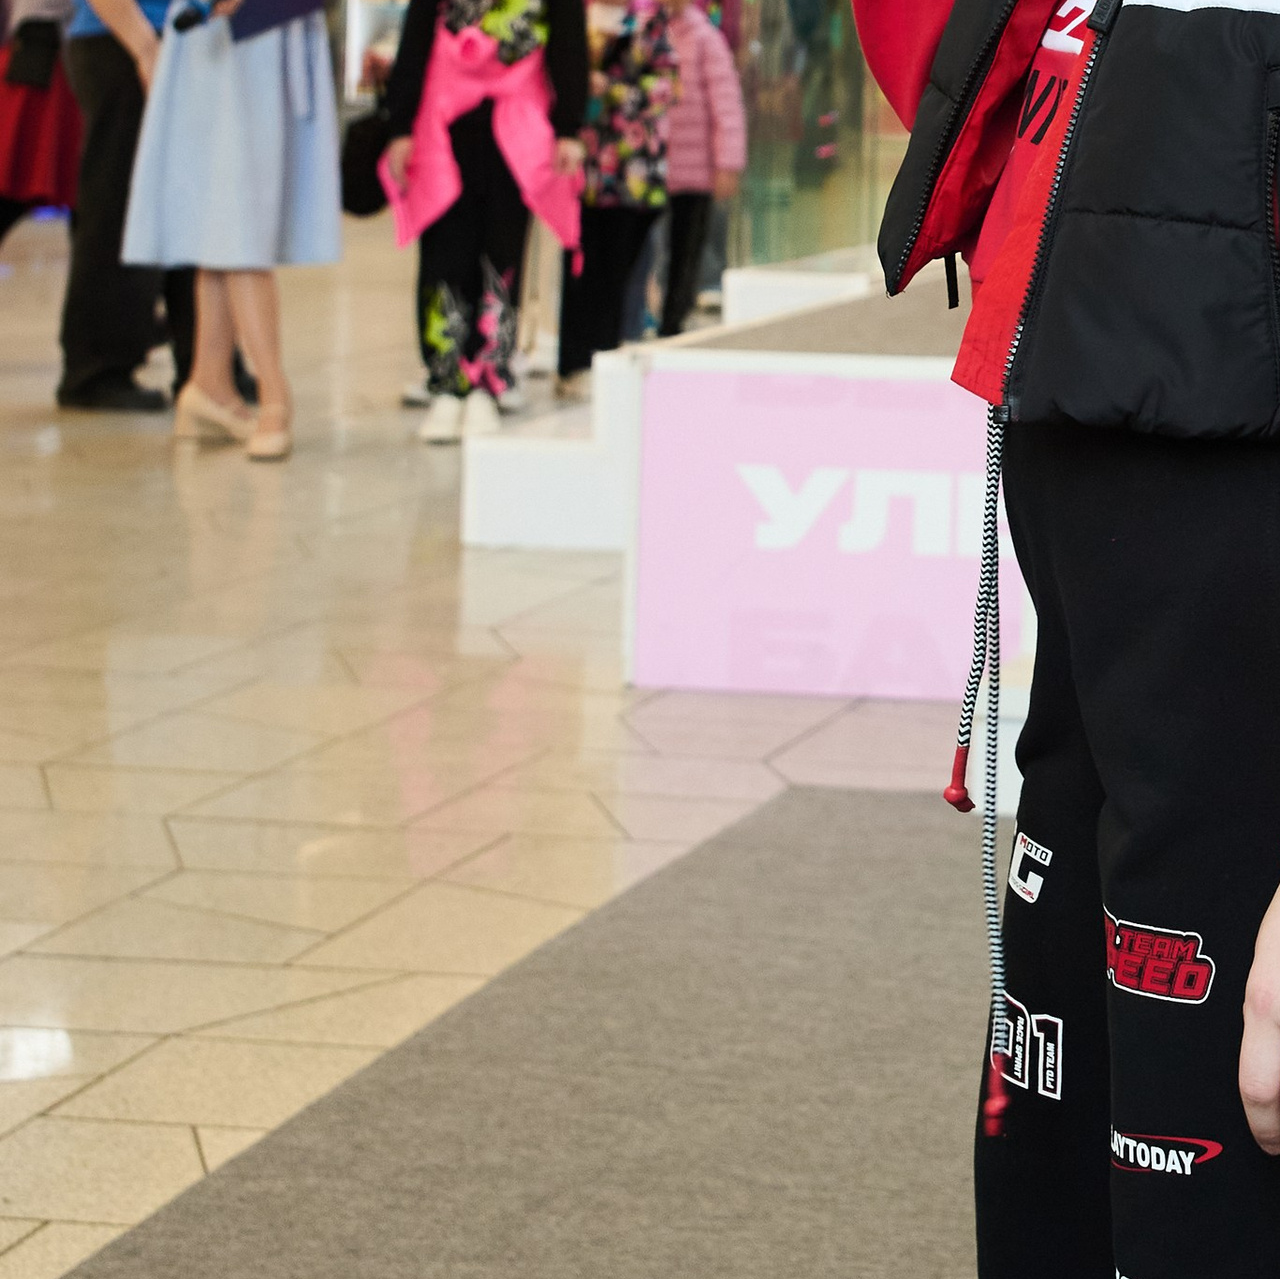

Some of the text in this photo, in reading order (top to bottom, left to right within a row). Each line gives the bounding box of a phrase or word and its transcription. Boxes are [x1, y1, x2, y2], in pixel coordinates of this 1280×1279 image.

[1020, 835, 1049, 862] MOTO
[1119, 928, 1198, 962] TEAM
[1108, 950, 1212, 999] EED
[1013, 1015, 1025, 1079] RACE SPIRIT
[1046, 1042, 1055, 1069] TEAM
